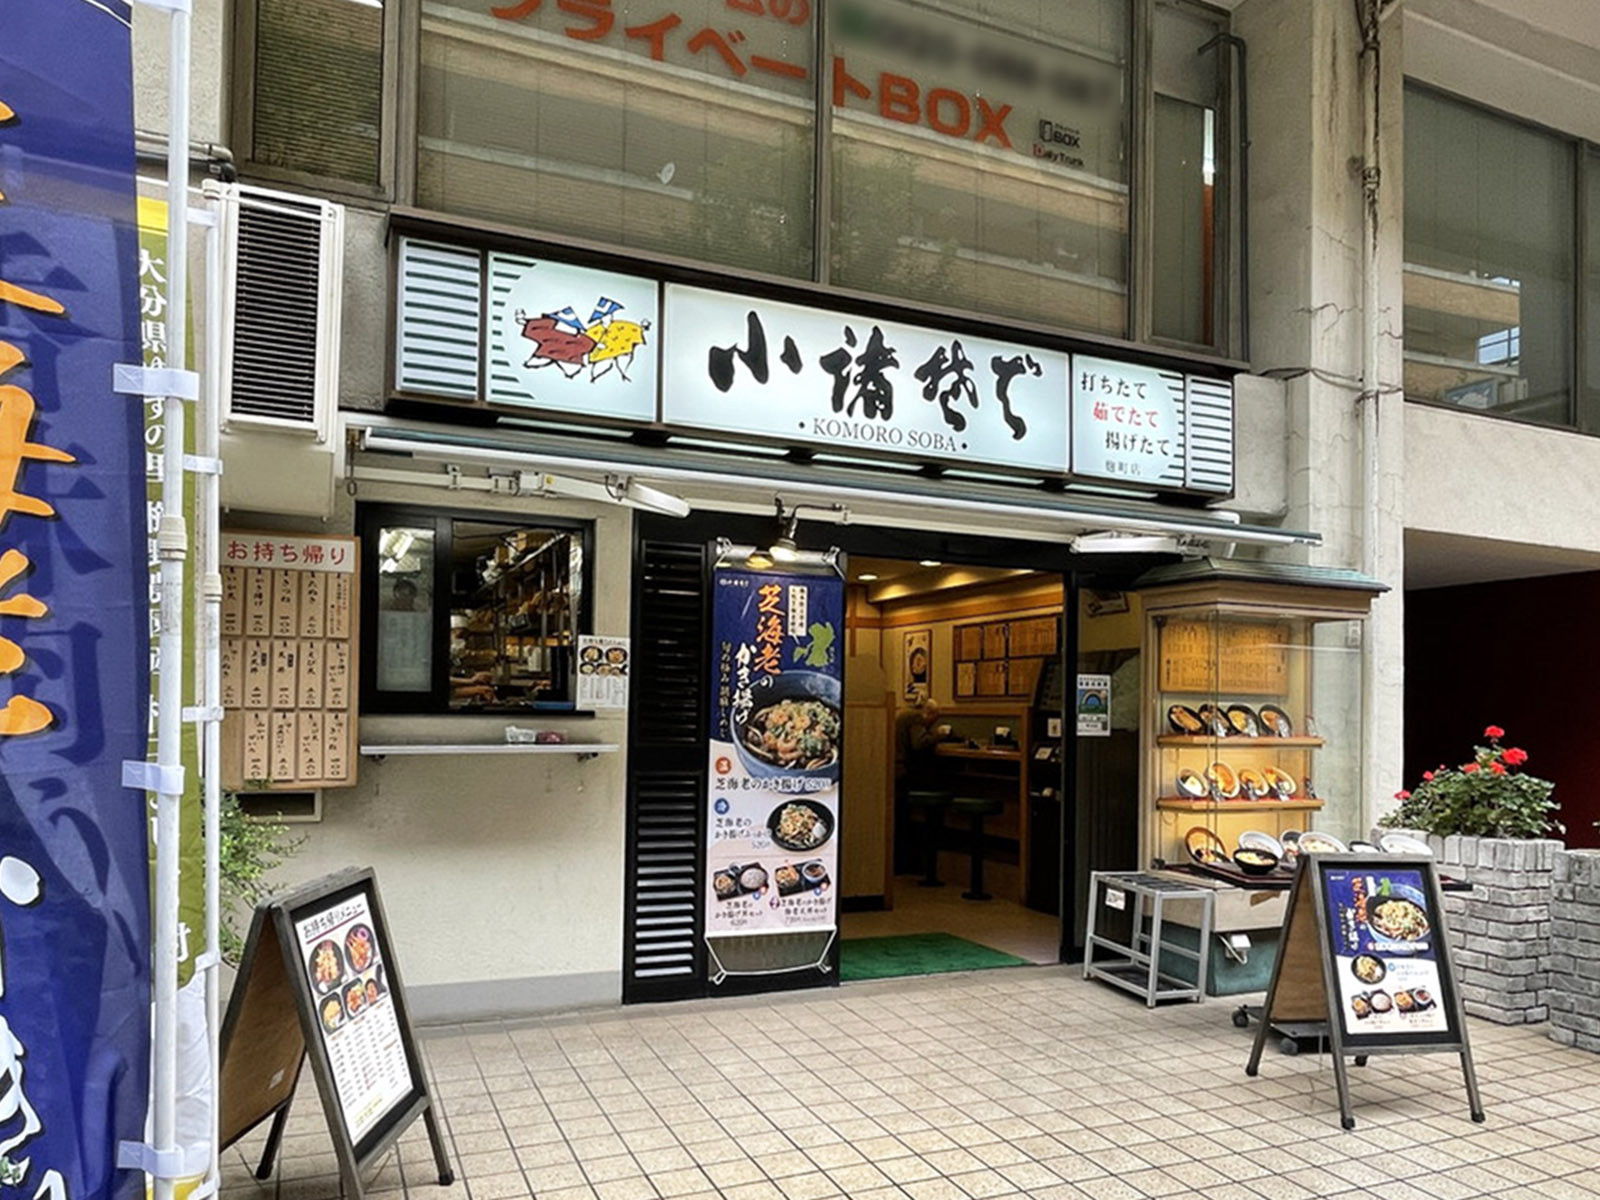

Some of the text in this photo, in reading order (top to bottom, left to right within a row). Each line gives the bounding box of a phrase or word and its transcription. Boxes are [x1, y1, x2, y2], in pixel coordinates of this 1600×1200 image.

[1081, 371, 1147, 399] 打ちたて
[1093, 400, 1159, 428] 茹でたて
[812, 417, 957, 452] KOMORO SOBA
[1105, 430, 1170, 456] 揚げたて
[227, 540, 345, 565] お持ち帰り
[732, 642, 757, 726] かき揚げ
